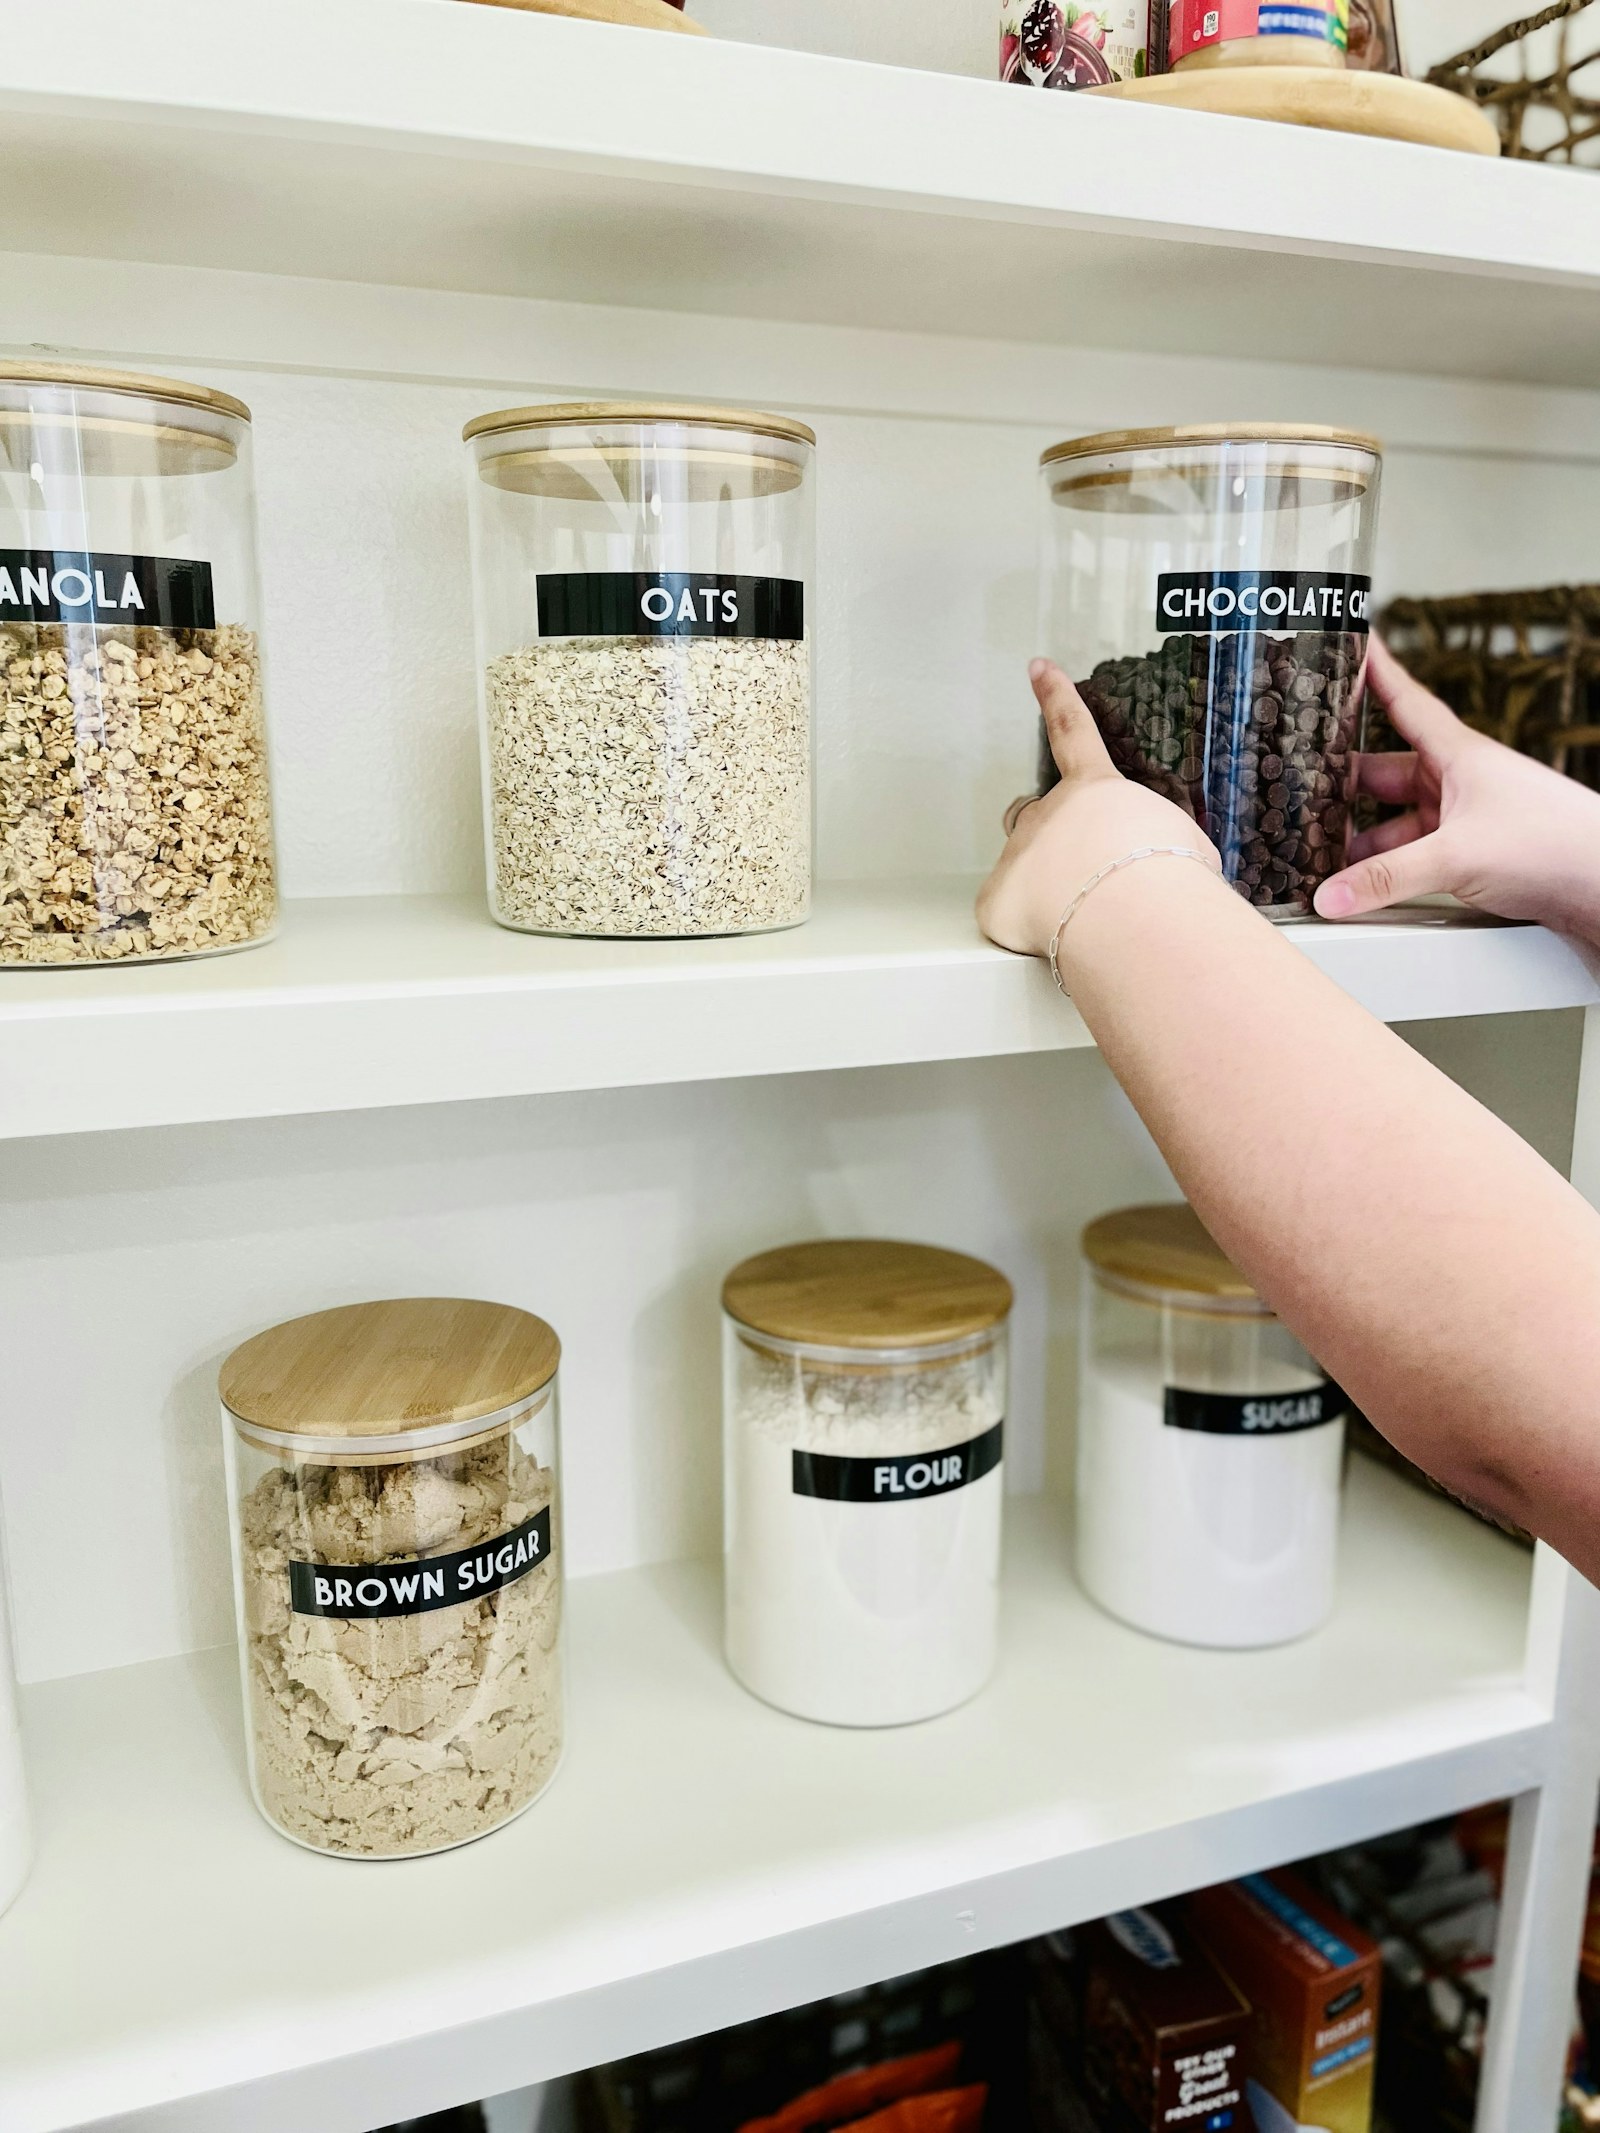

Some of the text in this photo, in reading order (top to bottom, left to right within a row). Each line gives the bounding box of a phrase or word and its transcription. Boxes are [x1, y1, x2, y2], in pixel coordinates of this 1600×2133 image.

[640, 587, 739, 623] OATS
[1162, 586, 1343, 618] CHOCOLATE
[1241, 1395, 1322, 1431] SUGAR
[874, 1455, 962, 1494] FLOUR
[314, 1529, 540, 1607] BROWN SUGAR
